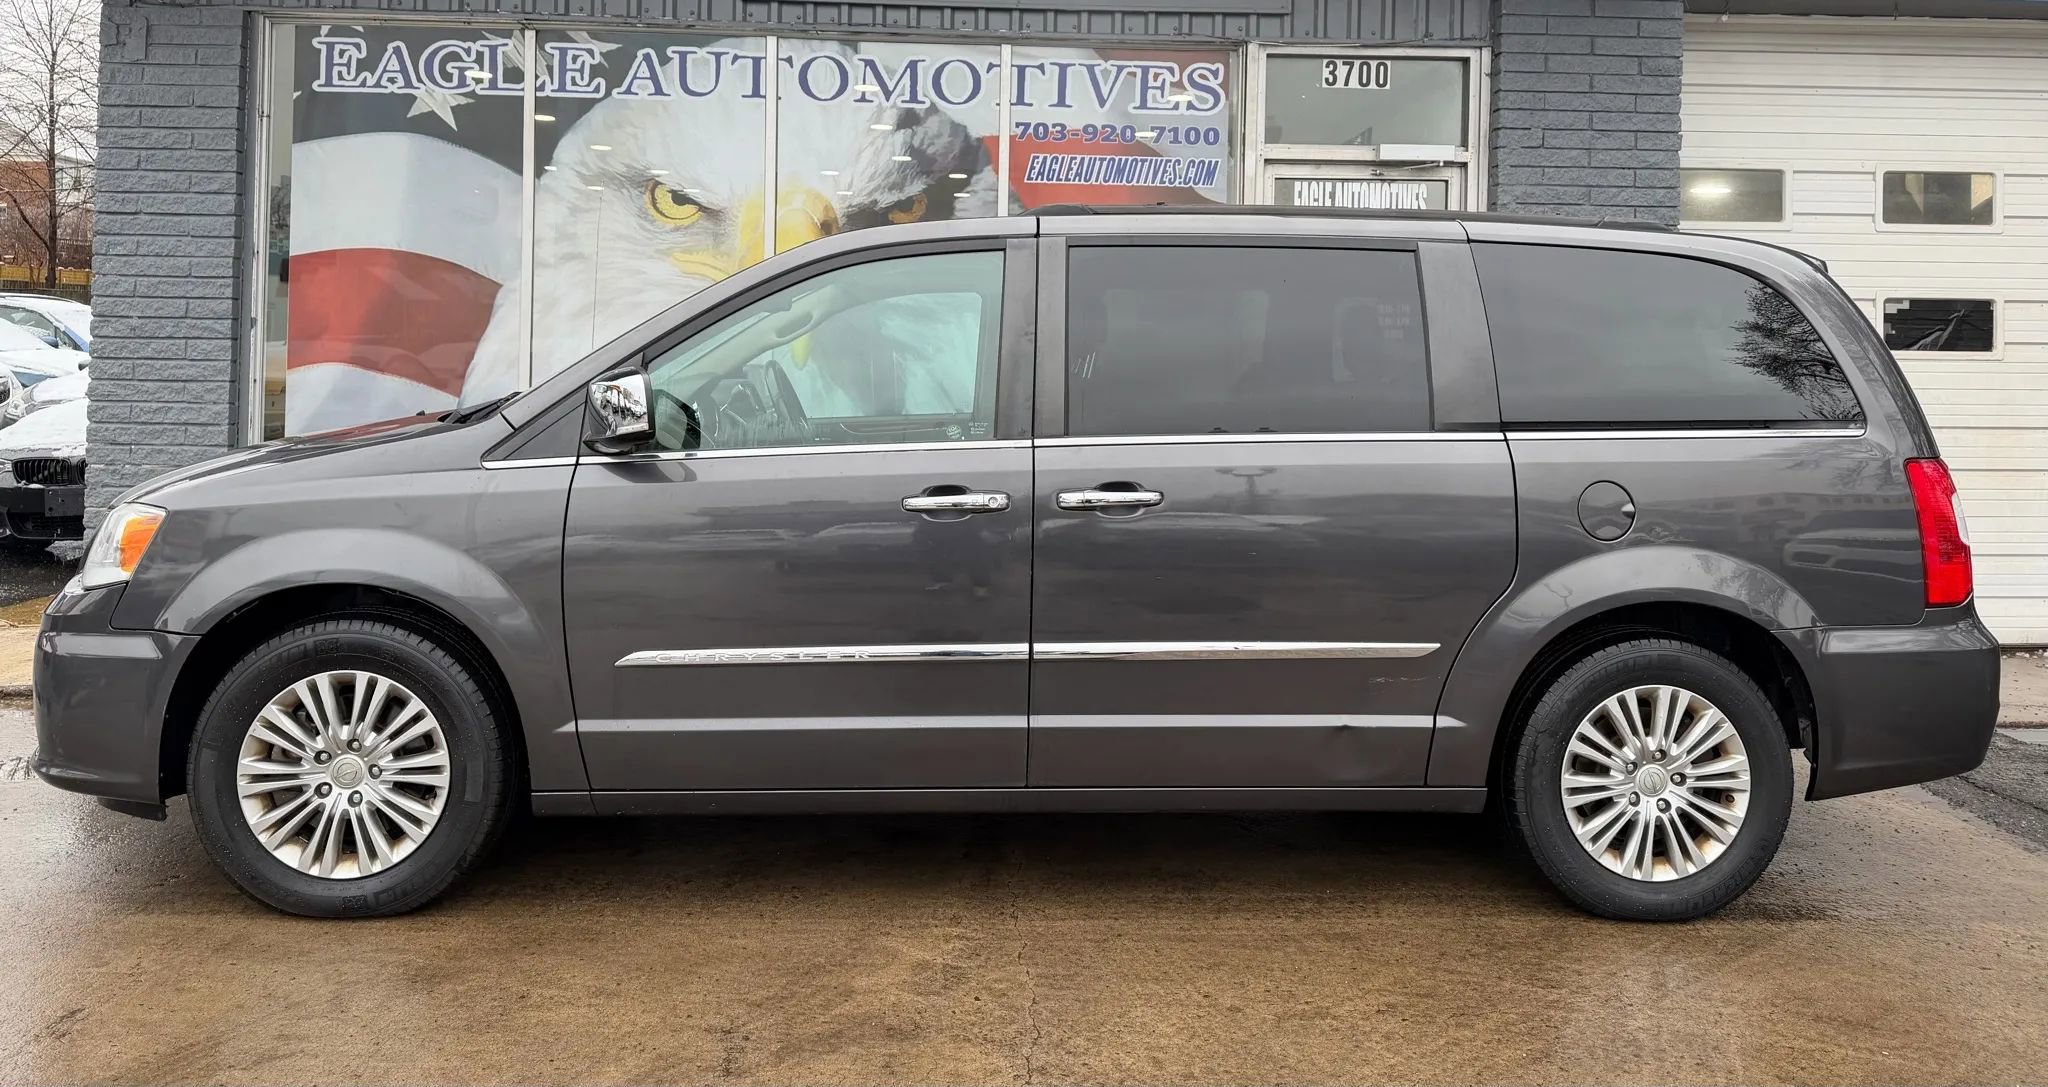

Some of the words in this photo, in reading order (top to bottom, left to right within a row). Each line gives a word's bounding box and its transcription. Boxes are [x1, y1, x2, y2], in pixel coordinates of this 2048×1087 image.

[313, 37, 605, 95] EAGLE
[613, 47, 1225, 113] AUTOMOTIVES
[1324, 60, 1389, 88] 3700
[1014, 121, 1221, 146] 703-920-7100
[1025, 154, 1220, 187] EAGLEAUTOMOTIVES.COM
[655, 650, 870, 663] CHRYSLER
